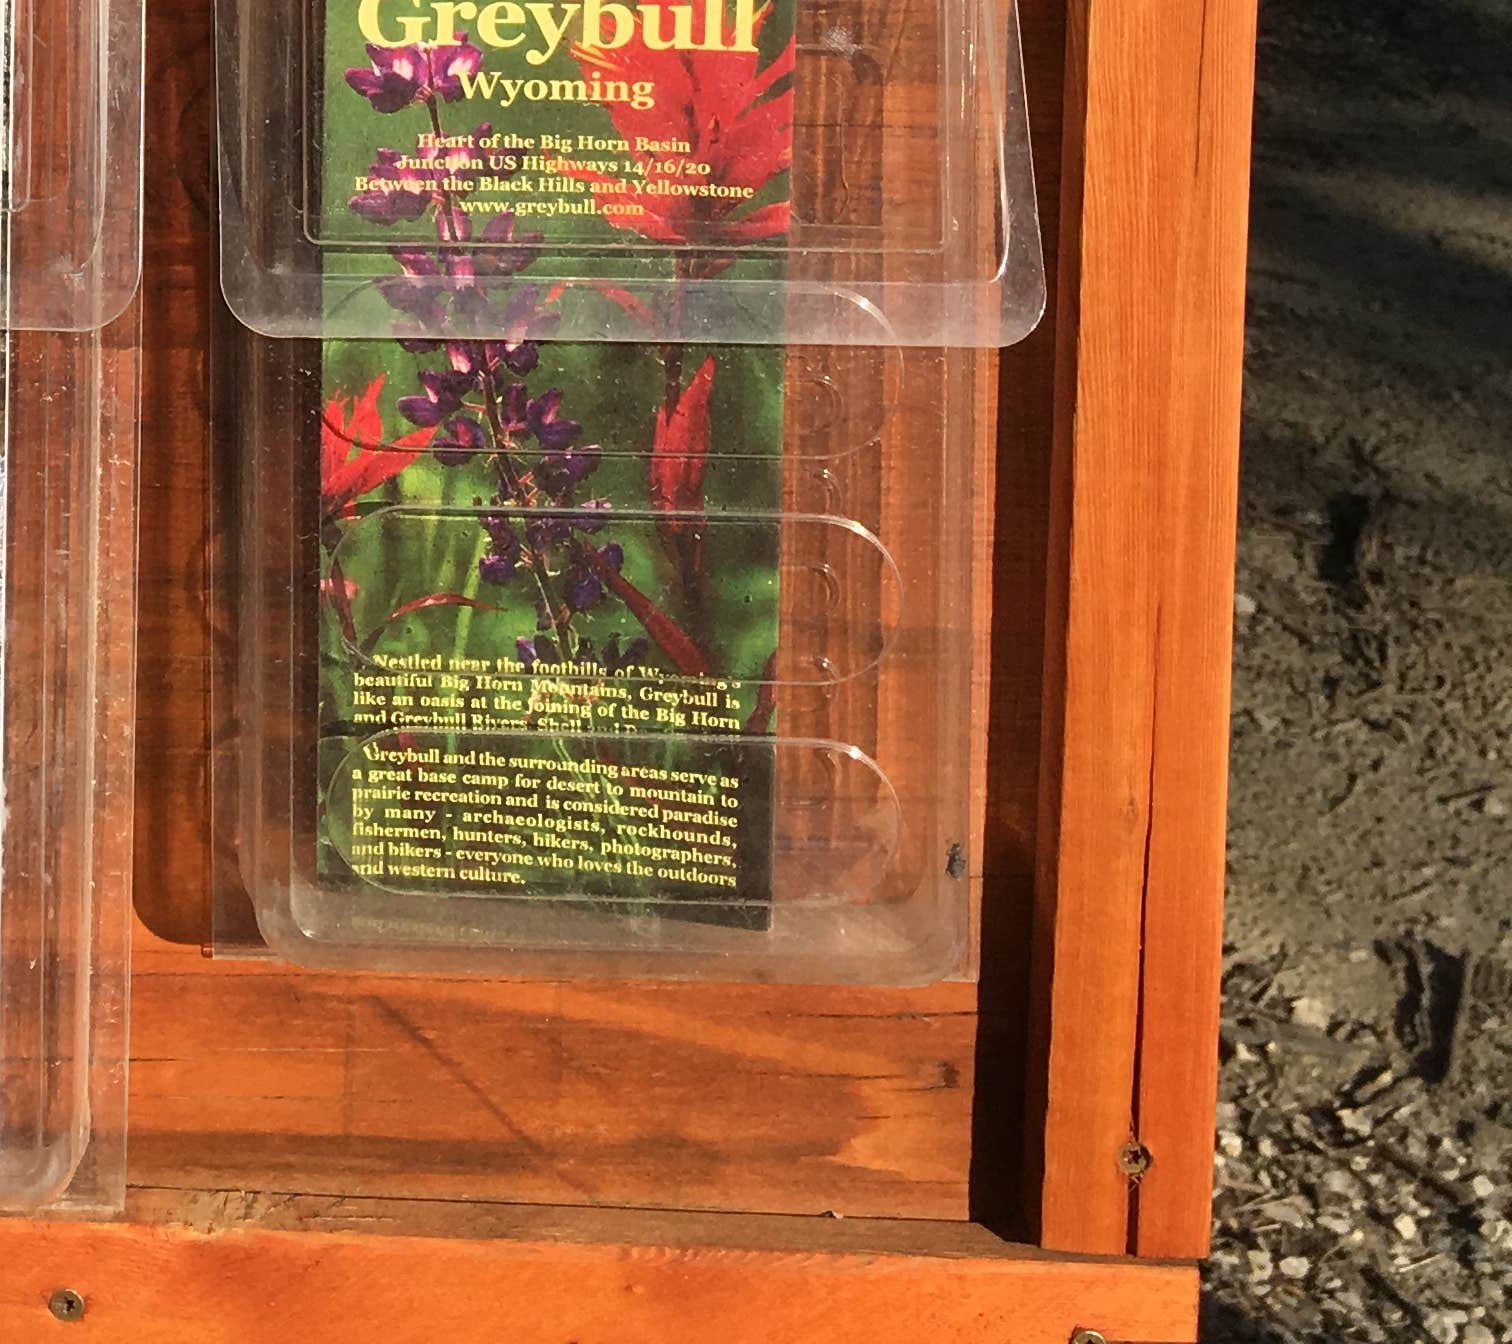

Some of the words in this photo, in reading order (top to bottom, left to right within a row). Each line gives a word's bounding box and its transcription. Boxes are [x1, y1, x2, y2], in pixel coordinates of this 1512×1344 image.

[457, 71, 655, 109] Wyoming
[417, 133, 475, 149] Heart
[479, 133, 502, 149] of
[503, 134, 535, 149] the
[540, 134, 573, 153] Big
[578, 135, 630, 151] Horn
[635, 136, 690, 153] Basin
[488, 155, 517, 170] US
[521, 155, 618, 174] Highways
[624, 157, 711, 177] 14/16/20
[355, 176, 438, 191] Between
[443, 176, 474, 191] the
[479, 176, 533, 192] Black
[539, 177, 585, 193] Hills
[589, 178, 627, 194] and
[632, 179, 754, 199] Yellowstone
[458, 198, 644, 217] www.greybull.com
[373, 654, 442, 672] Nestled
[449, 656, 491, 672] near
[496, 657, 525, 673] the
[531, 658, 607, 677] foothills
[614, 665, 634, 679] of
[354, 673, 433, 688] beautiful
[440, 674, 470, 691] Big
[476, 675, 523, 691] Horn
[530, 679, 632, 701] Mountains,
[640, 687, 718, 707] Greybull
[725, 694, 741, 709] is
[353, 691, 386, 706] like
[392, 694, 414, 706] an
[420, 693, 464, 708] oasis
[471, 696, 487, 710] at
[494, 696, 522, 711] the
[526, 698, 592, 718] joining
[597, 703, 617, 718] of
[621, 704, 651, 720] the
[656, 708, 686, 726] Big
[692, 711, 741, 730] Horn
[353, 710, 386, 724] and
[443, 750, 476, 765] and
[479, 752, 508, 767] the
[509, 757, 618, 779] surrounding
[621, 766, 667, 781] areas
[670, 770, 717, 785] serve
[719, 775, 739, 788] as
[352, 769, 362, 780] a
[368, 769, 412, 784] great
[418, 768, 457, 784] base
[462, 774, 509, 789] camp
[515, 774, 541, 789] for
[546, 776, 600, 794] desert
[606, 782, 623, 796] to
[630, 786, 715, 806] mountain
[721, 794, 738, 808] to
[352, 786, 411, 803] prairie
[414, 789, 502, 806] recreation
[505, 794, 538, 809] and
[545, 795, 560, 810] is
[562, 798, 659, 819] considered
[662, 807, 738, 828] paradise
[352, 804, 374, 820] by
[384, 808, 437, 823] many
[462, 810, 606, 834] archaeologists,
[616, 823, 738, 849] rockhounds,
[352, 823, 447, 842] fishermen,
[453, 826, 527, 847] hunters,
[533, 832, 594, 851] hikers,
[600, 838, 737, 869] photographers,
[351, 842, 384, 856] and
[388, 842, 442, 858] bikers
[455, 850, 533, 866] everyone
[537, 853, 574, 869] who
[578, 855, 622, 873] loves
[626, 859, 654, 877] the
[657, 867, 737, 888] outdoors
[388, 864, 456, 879] western
[459, 867, 526, 885] culture.
